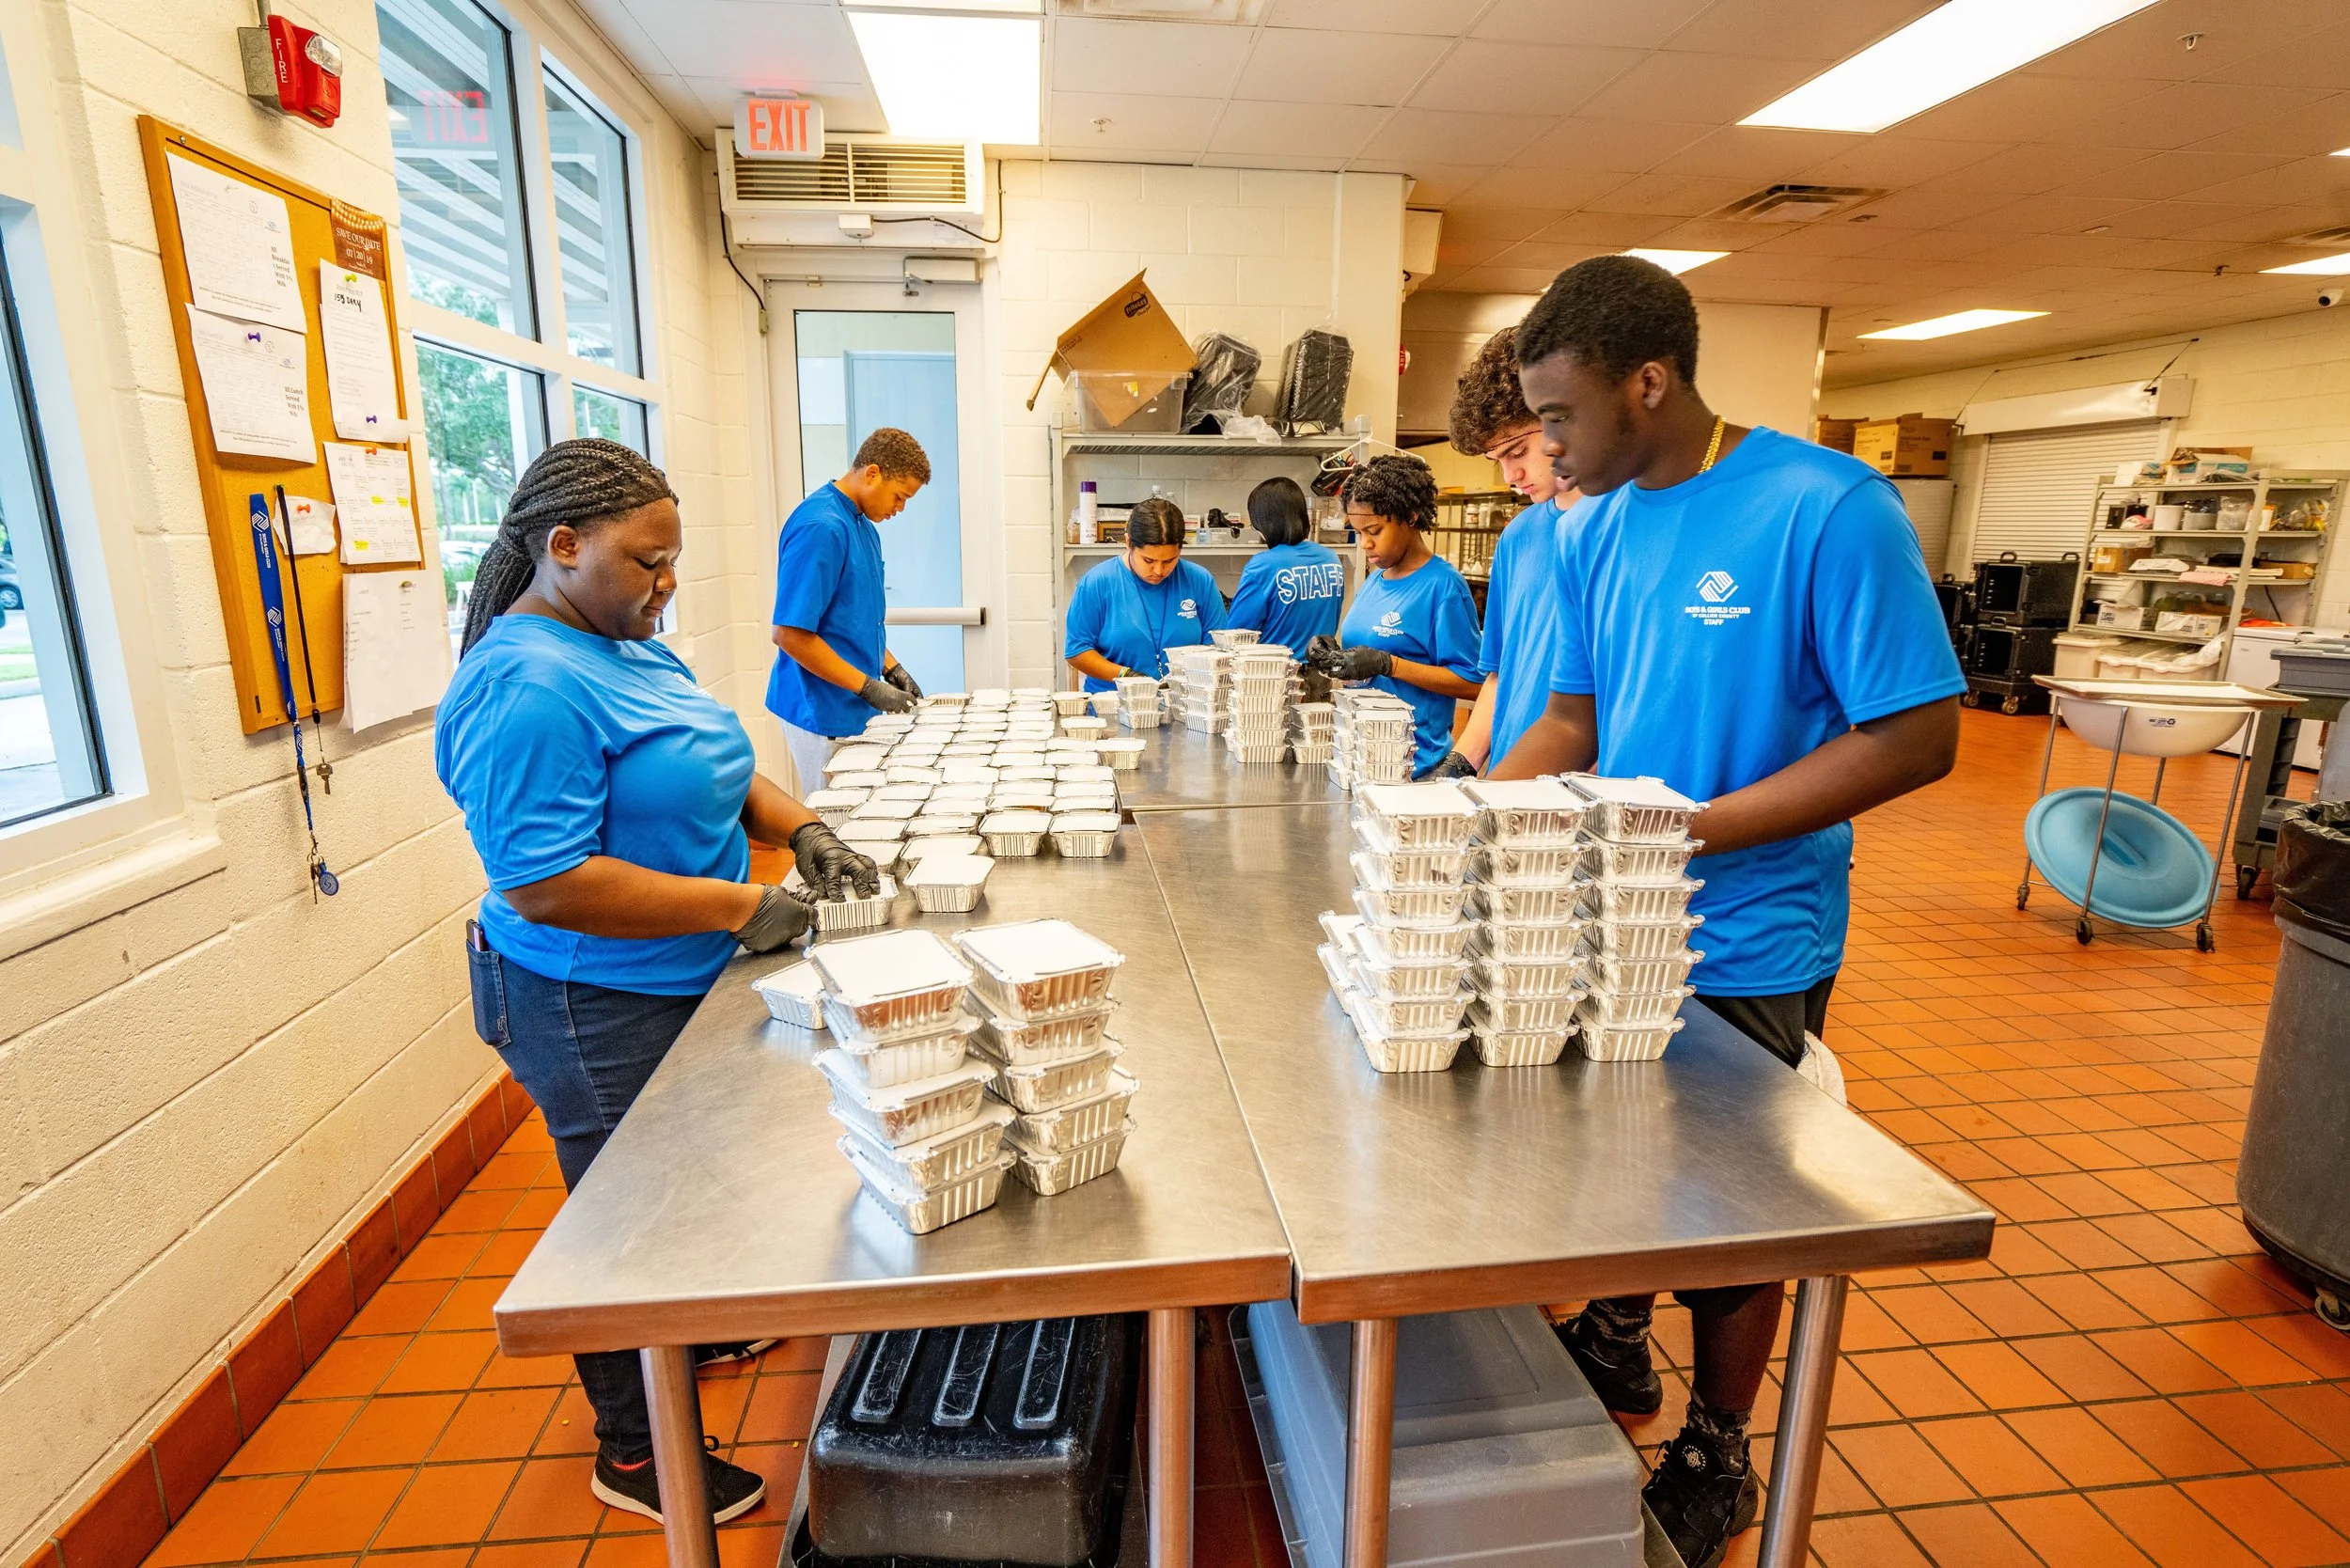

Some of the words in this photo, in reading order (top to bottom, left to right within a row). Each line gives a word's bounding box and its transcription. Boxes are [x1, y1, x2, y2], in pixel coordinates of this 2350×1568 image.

[275, 39, 288, 83] FIRE
[748, 99, 811, 152] EXIT
[337, 227, 352, 241] SAVE
[352, 232, 366, 245] OUR
[365, 238, 381, 251] DATE
[1276, 564, 1344, 604] STAFF
